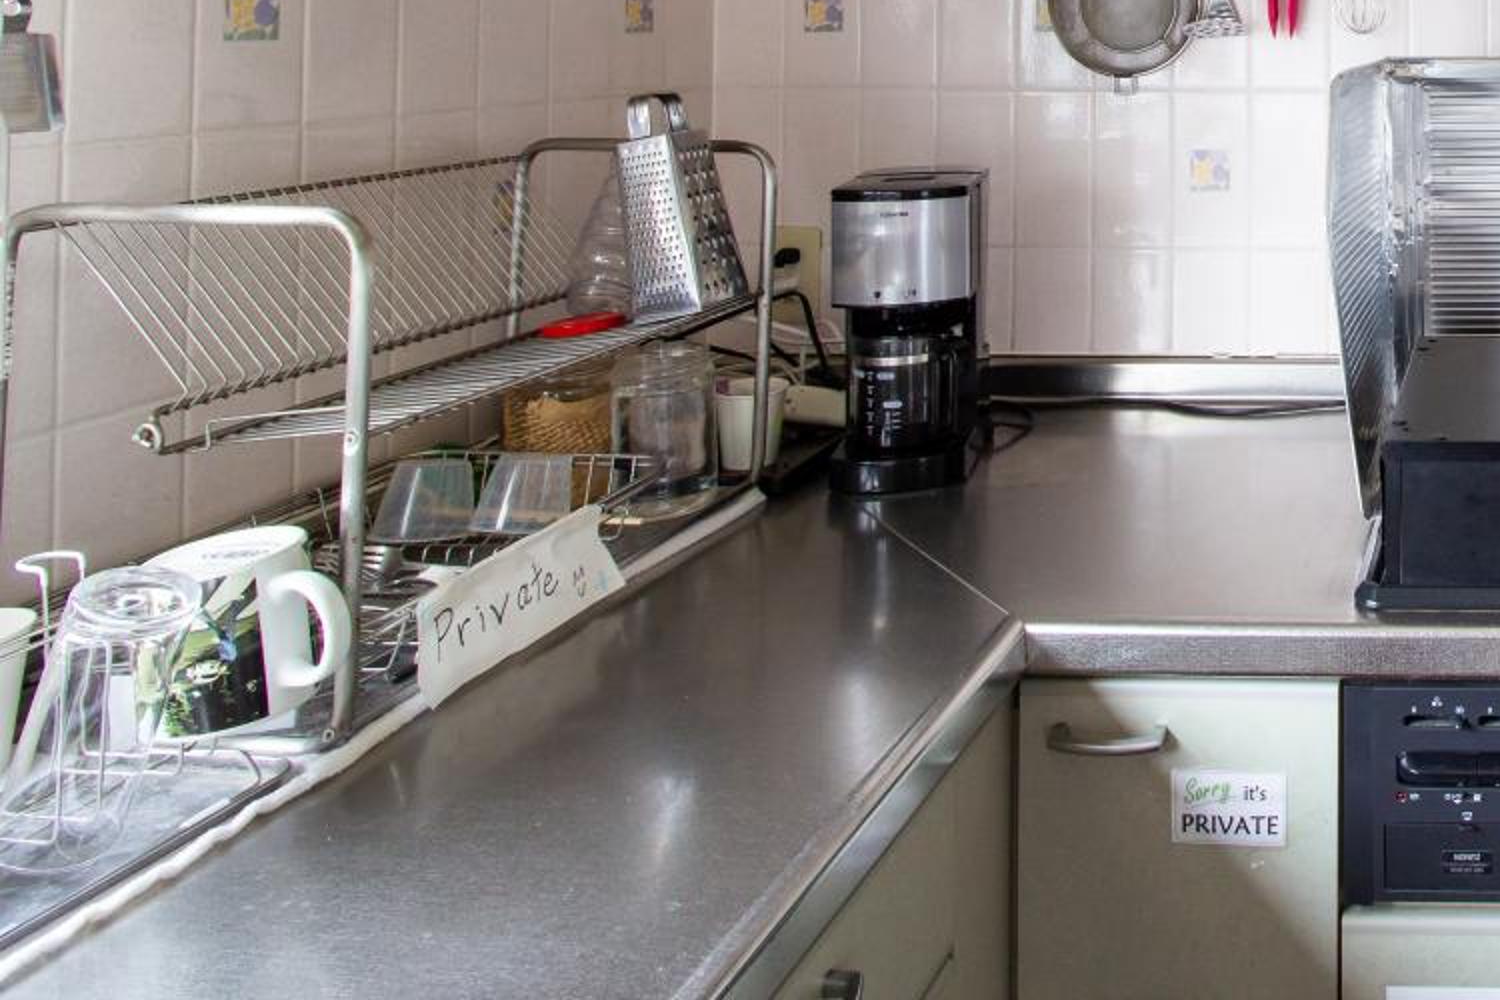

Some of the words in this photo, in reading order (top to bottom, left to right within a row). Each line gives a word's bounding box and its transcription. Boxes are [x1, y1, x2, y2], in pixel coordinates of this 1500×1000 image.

[433, 560, 559, 664] Private
[1183, 777, 1232, 805] Sorry
[1242, 785, 1267, 801] it's
[1181, 813, 1279, 836] PRIVATE
